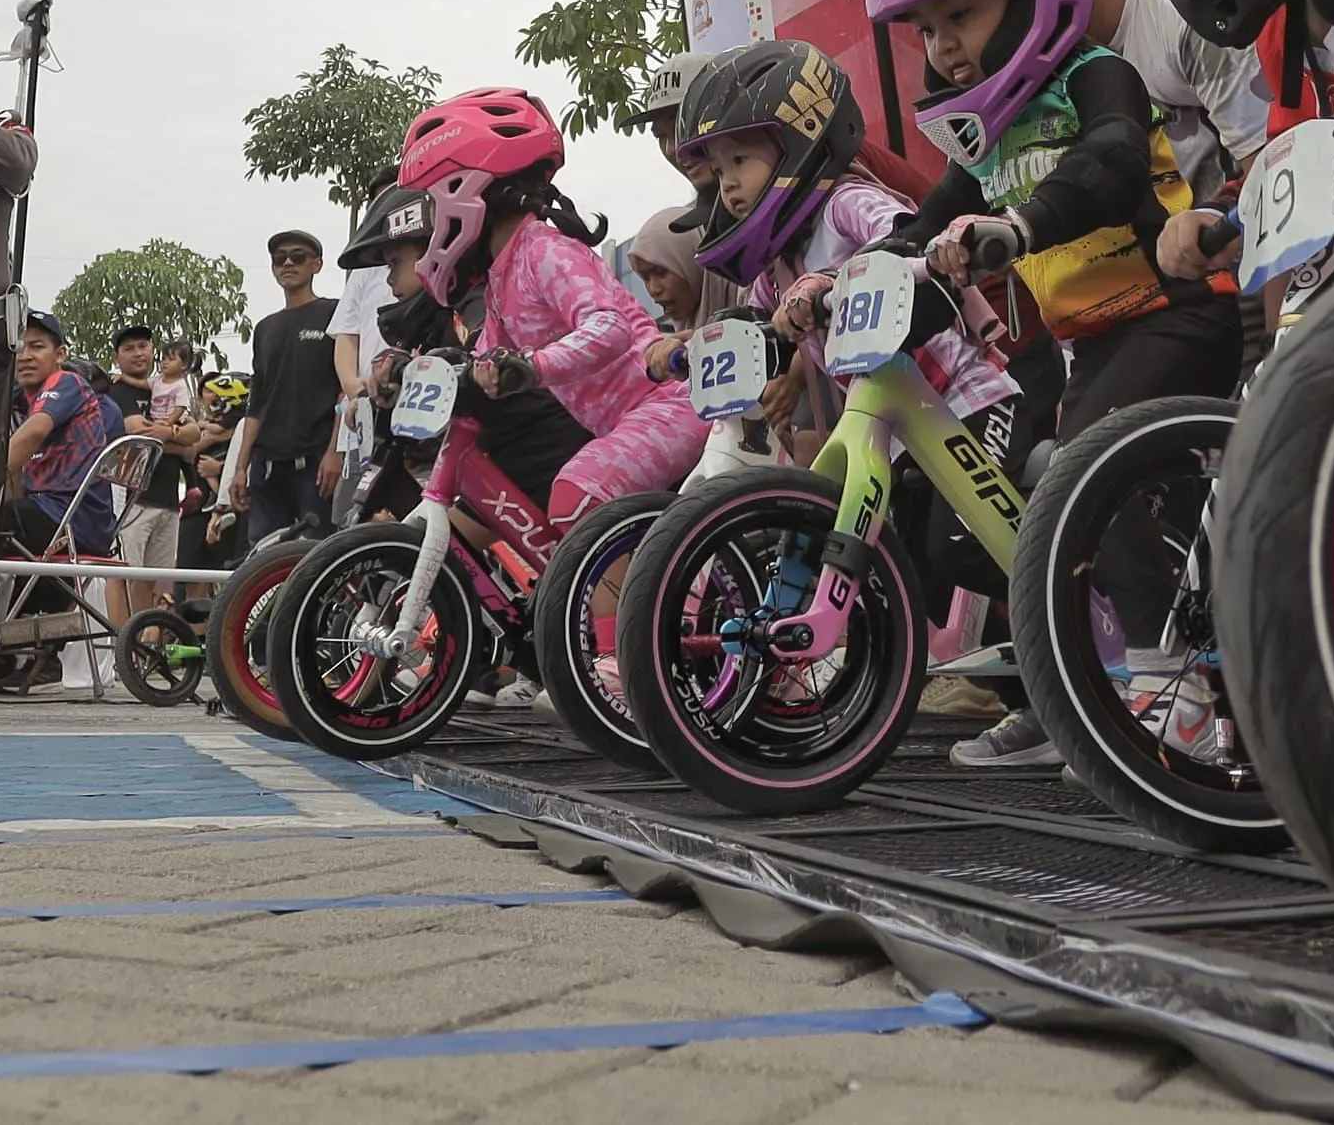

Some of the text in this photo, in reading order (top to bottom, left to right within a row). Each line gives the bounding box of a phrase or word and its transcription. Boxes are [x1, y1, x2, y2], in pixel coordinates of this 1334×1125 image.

[835, 289, 885, 337] 381
[701, 350, 736, 390] 22
[398, 381, 442, 413] 222
